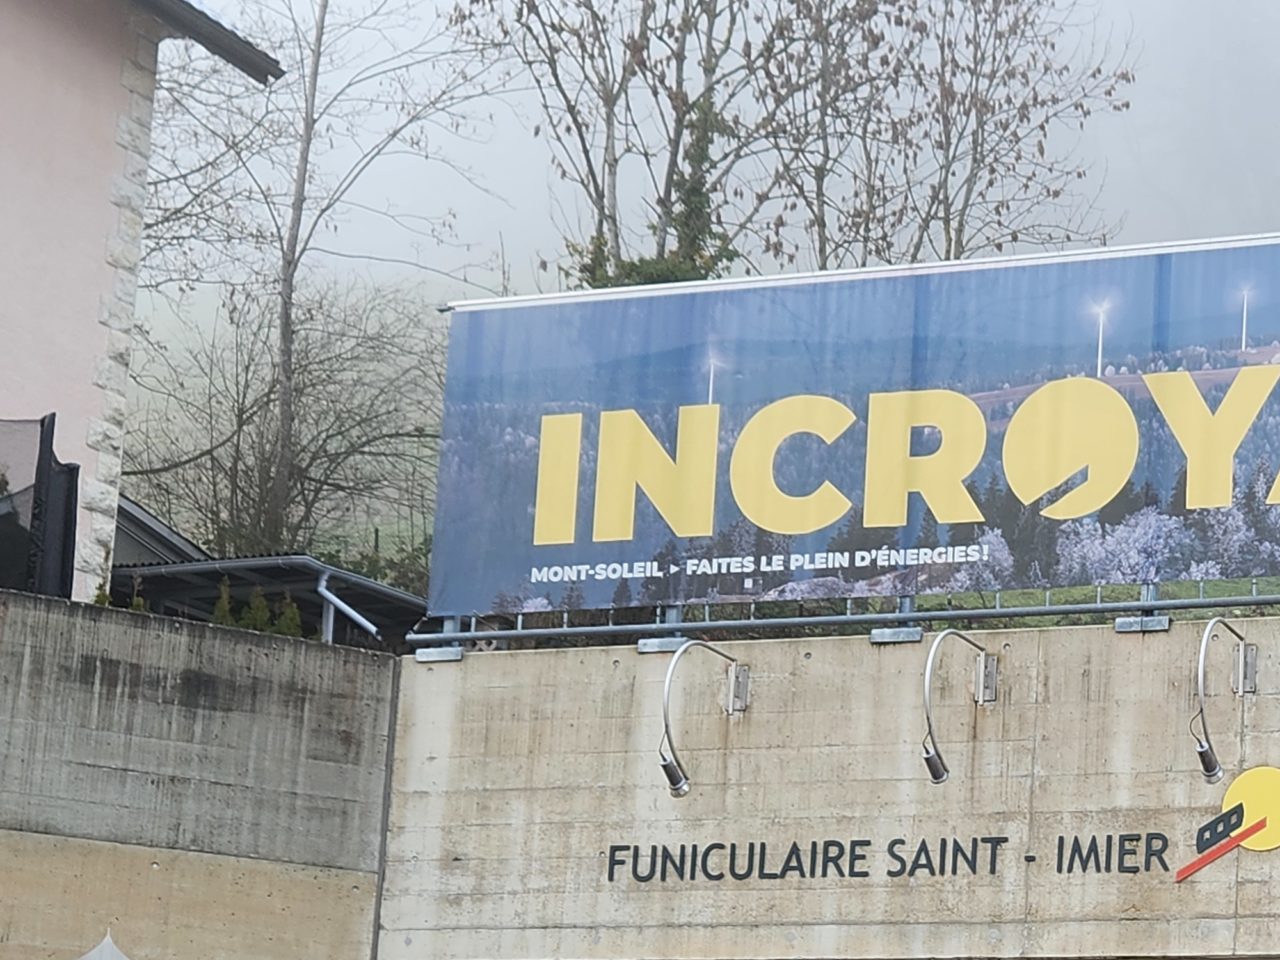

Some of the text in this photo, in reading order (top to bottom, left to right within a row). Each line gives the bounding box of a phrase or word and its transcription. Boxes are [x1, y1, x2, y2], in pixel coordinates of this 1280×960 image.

[531, 560, 663, 583] MONT-SOLEIL
[686, 555, 755, 576] FAITES
[760, 554, 784, 573] LE
[789, 551, 850, 571] PLEIN
[607, 839, 871, 882] FUNICULAIRE
[886, 836, 1009, 878] SAINT
[1055, 831, 1171, 874] IMIER
